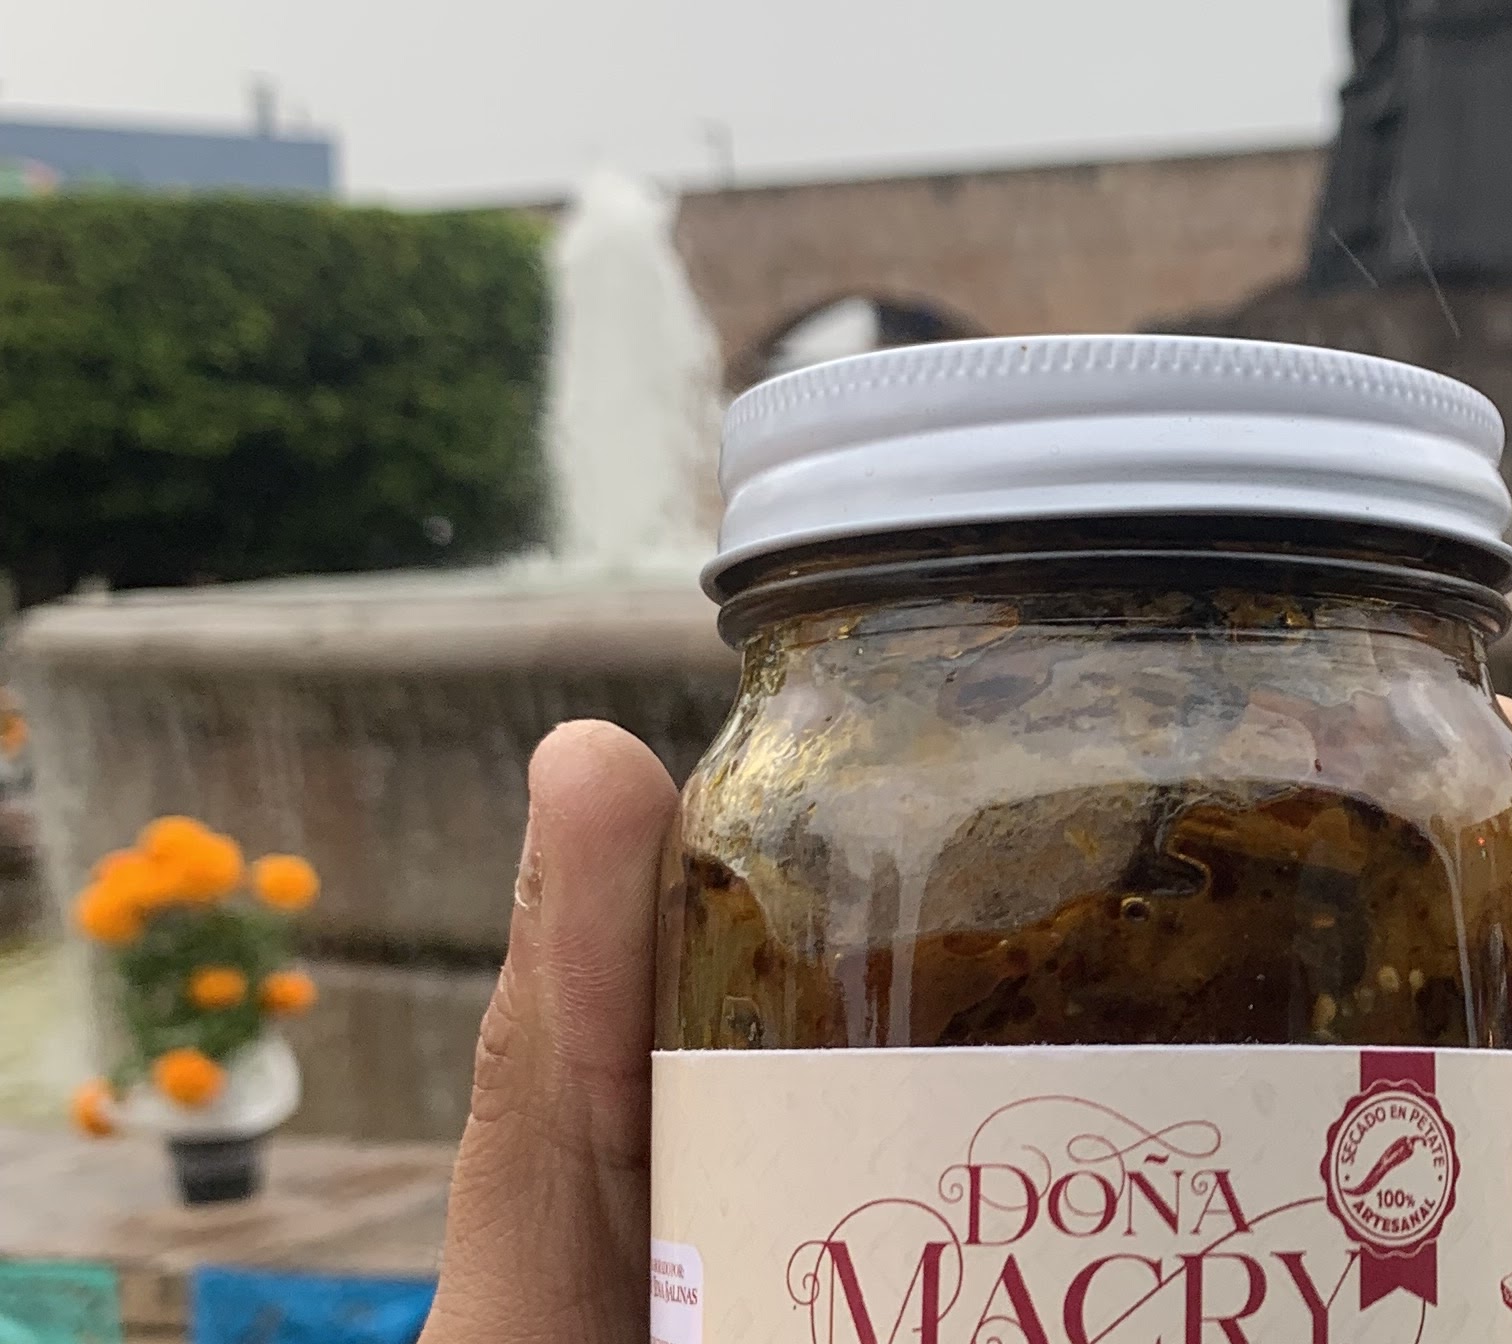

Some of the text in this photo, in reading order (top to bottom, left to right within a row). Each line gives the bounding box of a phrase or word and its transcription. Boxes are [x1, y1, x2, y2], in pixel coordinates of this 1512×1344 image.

[1341, 1103, 1446, 1169] SECADO EN PETATE
[941, 1152, 1255, 1247] DOÑA
[1351, 1197, 1437, 1234] ARTESANAL
[1376, 1188, 1416, 1209] 100%
